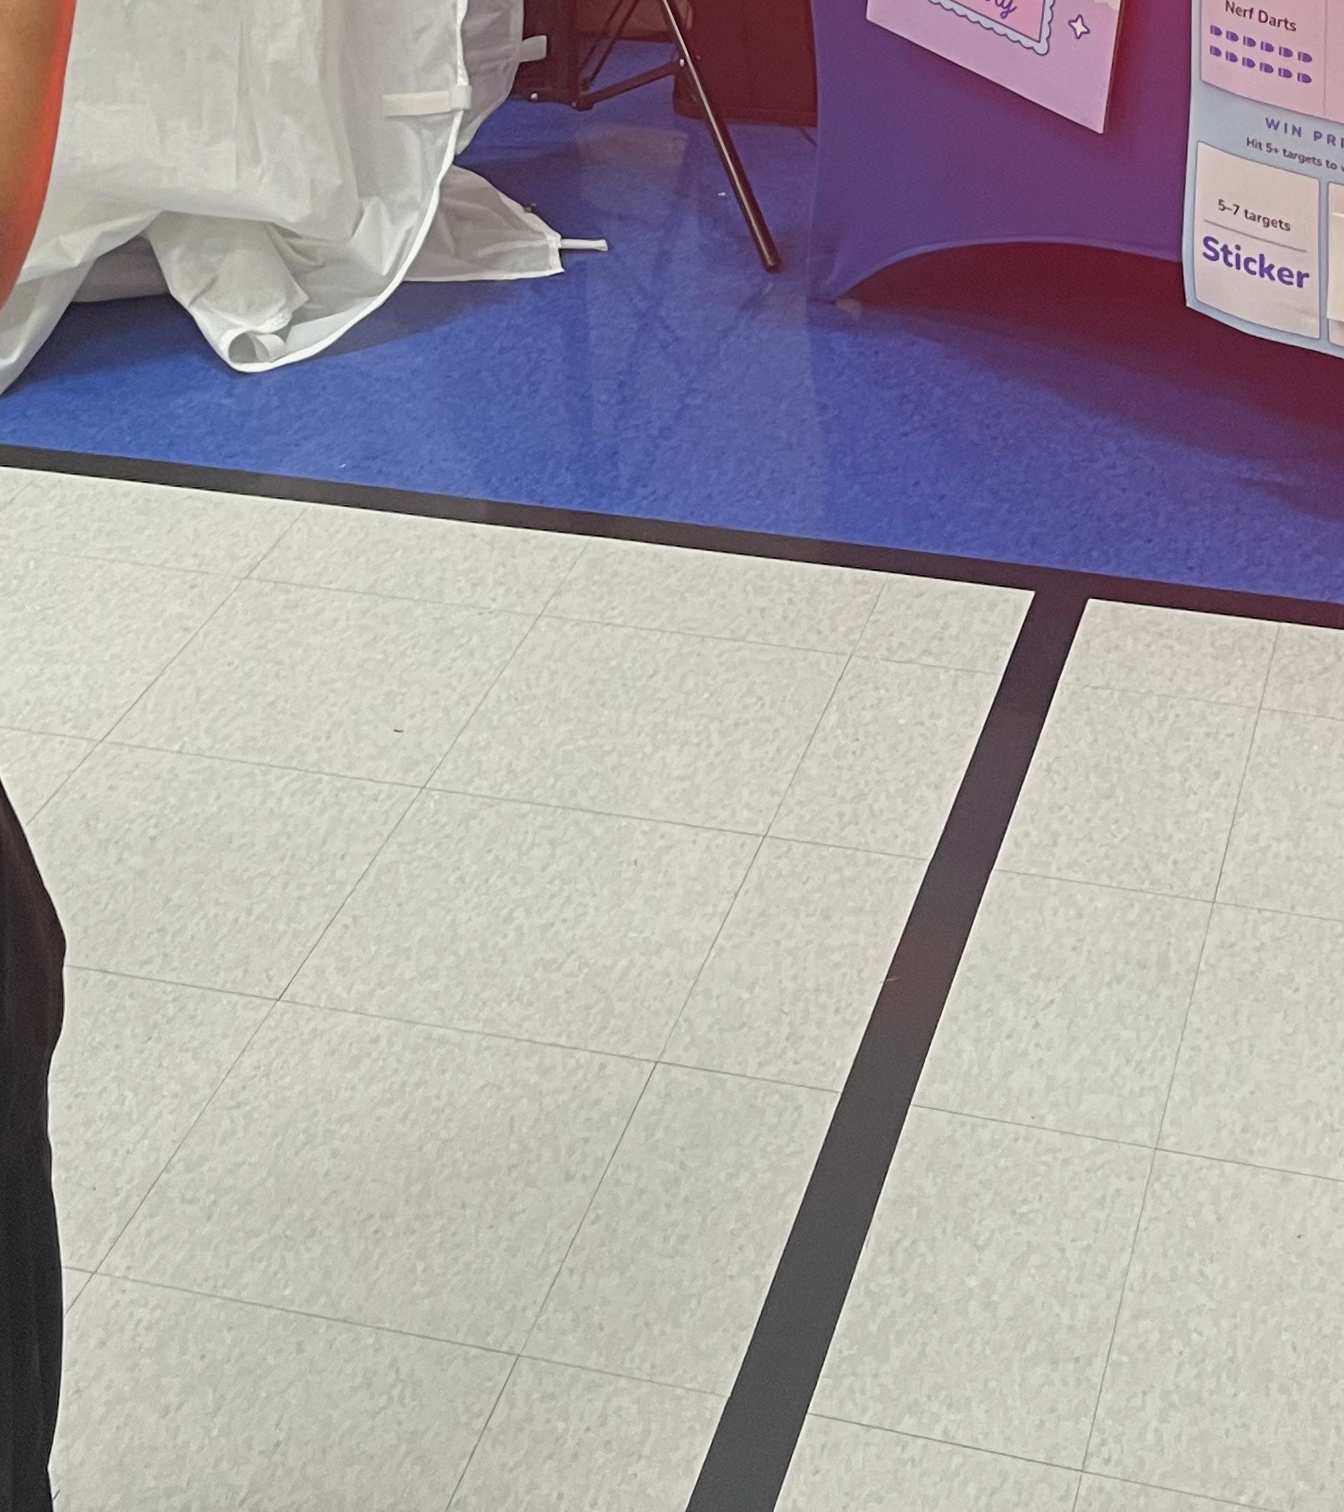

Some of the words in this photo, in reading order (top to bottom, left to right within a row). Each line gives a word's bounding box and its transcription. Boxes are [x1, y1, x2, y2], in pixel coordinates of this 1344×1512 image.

[1224, 0, 1255, 20] Nerf
[1257, 9, 1297, 32] Darts
[1264, 117, 1302, 138] WIN
[1246, 137, 1263, 151] Hit
[1265, 142, 1279, 154] 5+
[1282, 148, 1323, 167] targets
[1325, 159, 1338, 171] to
[1244, 208, 1291, 232] targets
[1202, 235, 1310, 288] Sticker
